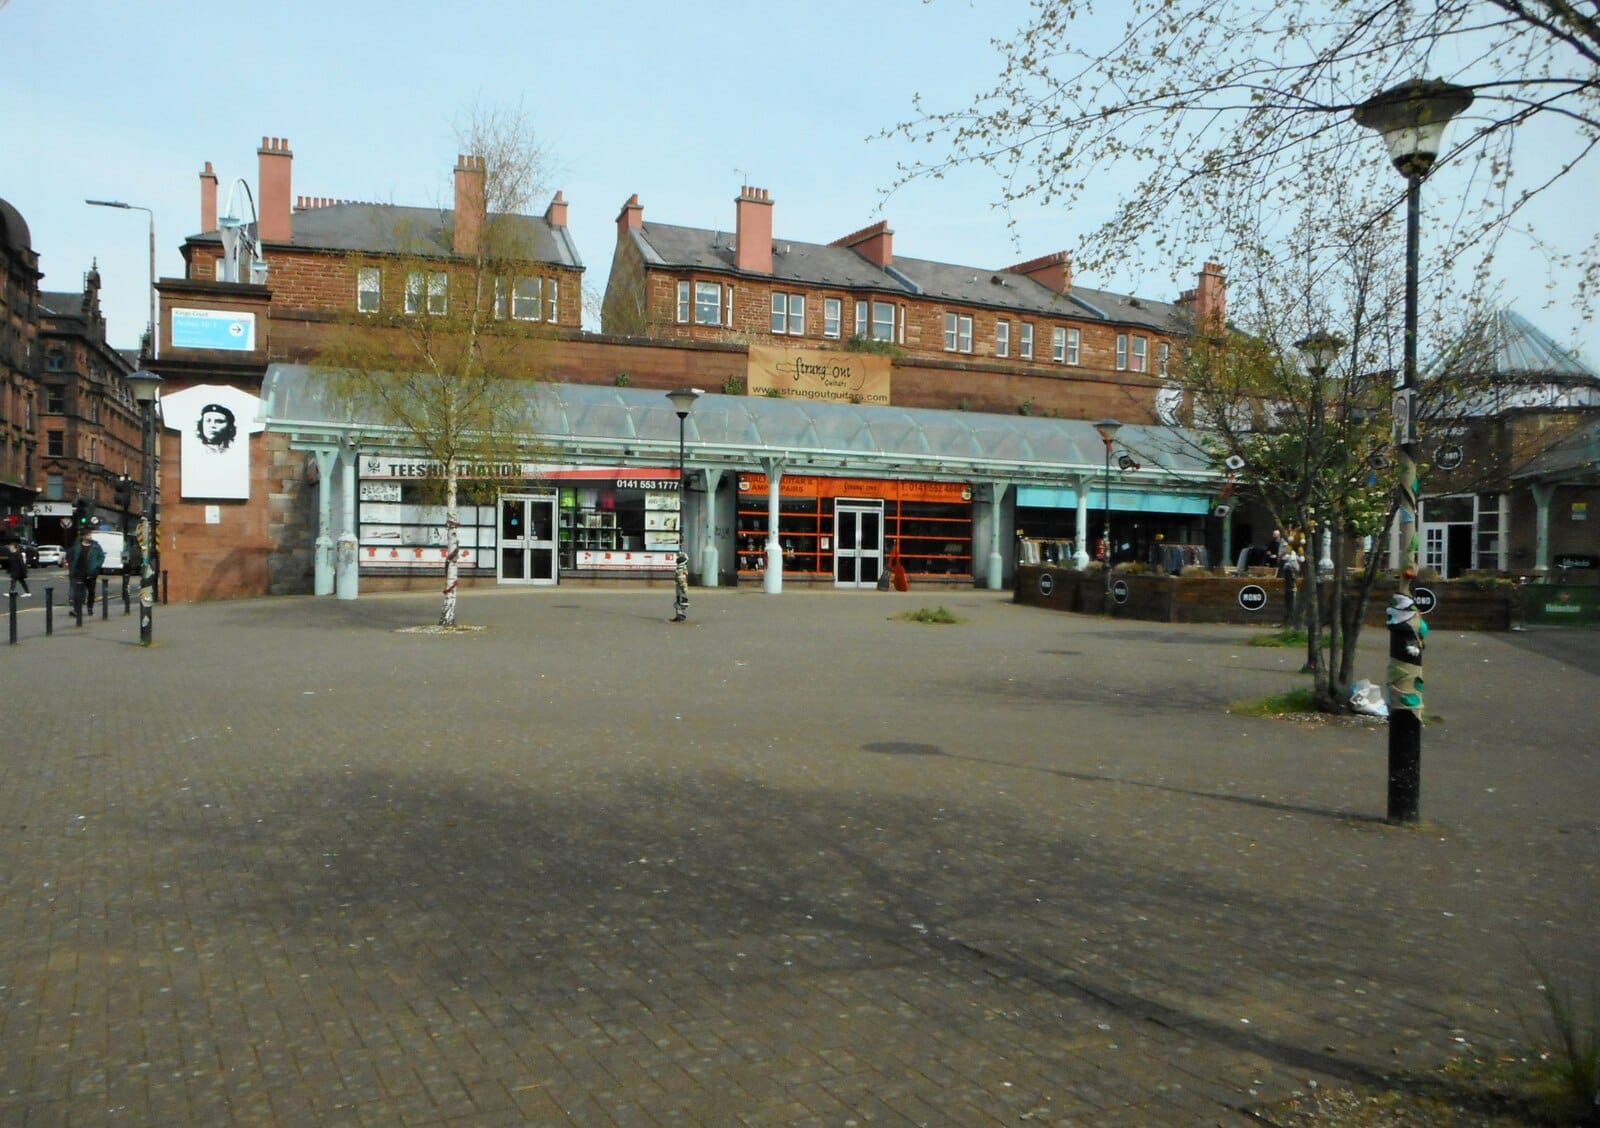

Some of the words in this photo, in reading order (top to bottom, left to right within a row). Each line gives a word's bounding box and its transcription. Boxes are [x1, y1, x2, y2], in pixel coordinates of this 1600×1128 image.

[793, 357, 826, 381] Strung
[832, 366, 851, 378] Out
[752, 386, 888, 401] wwstrungoutguitars.com
[617, 480, 638, 488] 0141
[640, 480, 656, 489] 553
[658, 481, 679, 490] 1777
[1243, 593, 1262, 601] MONO
